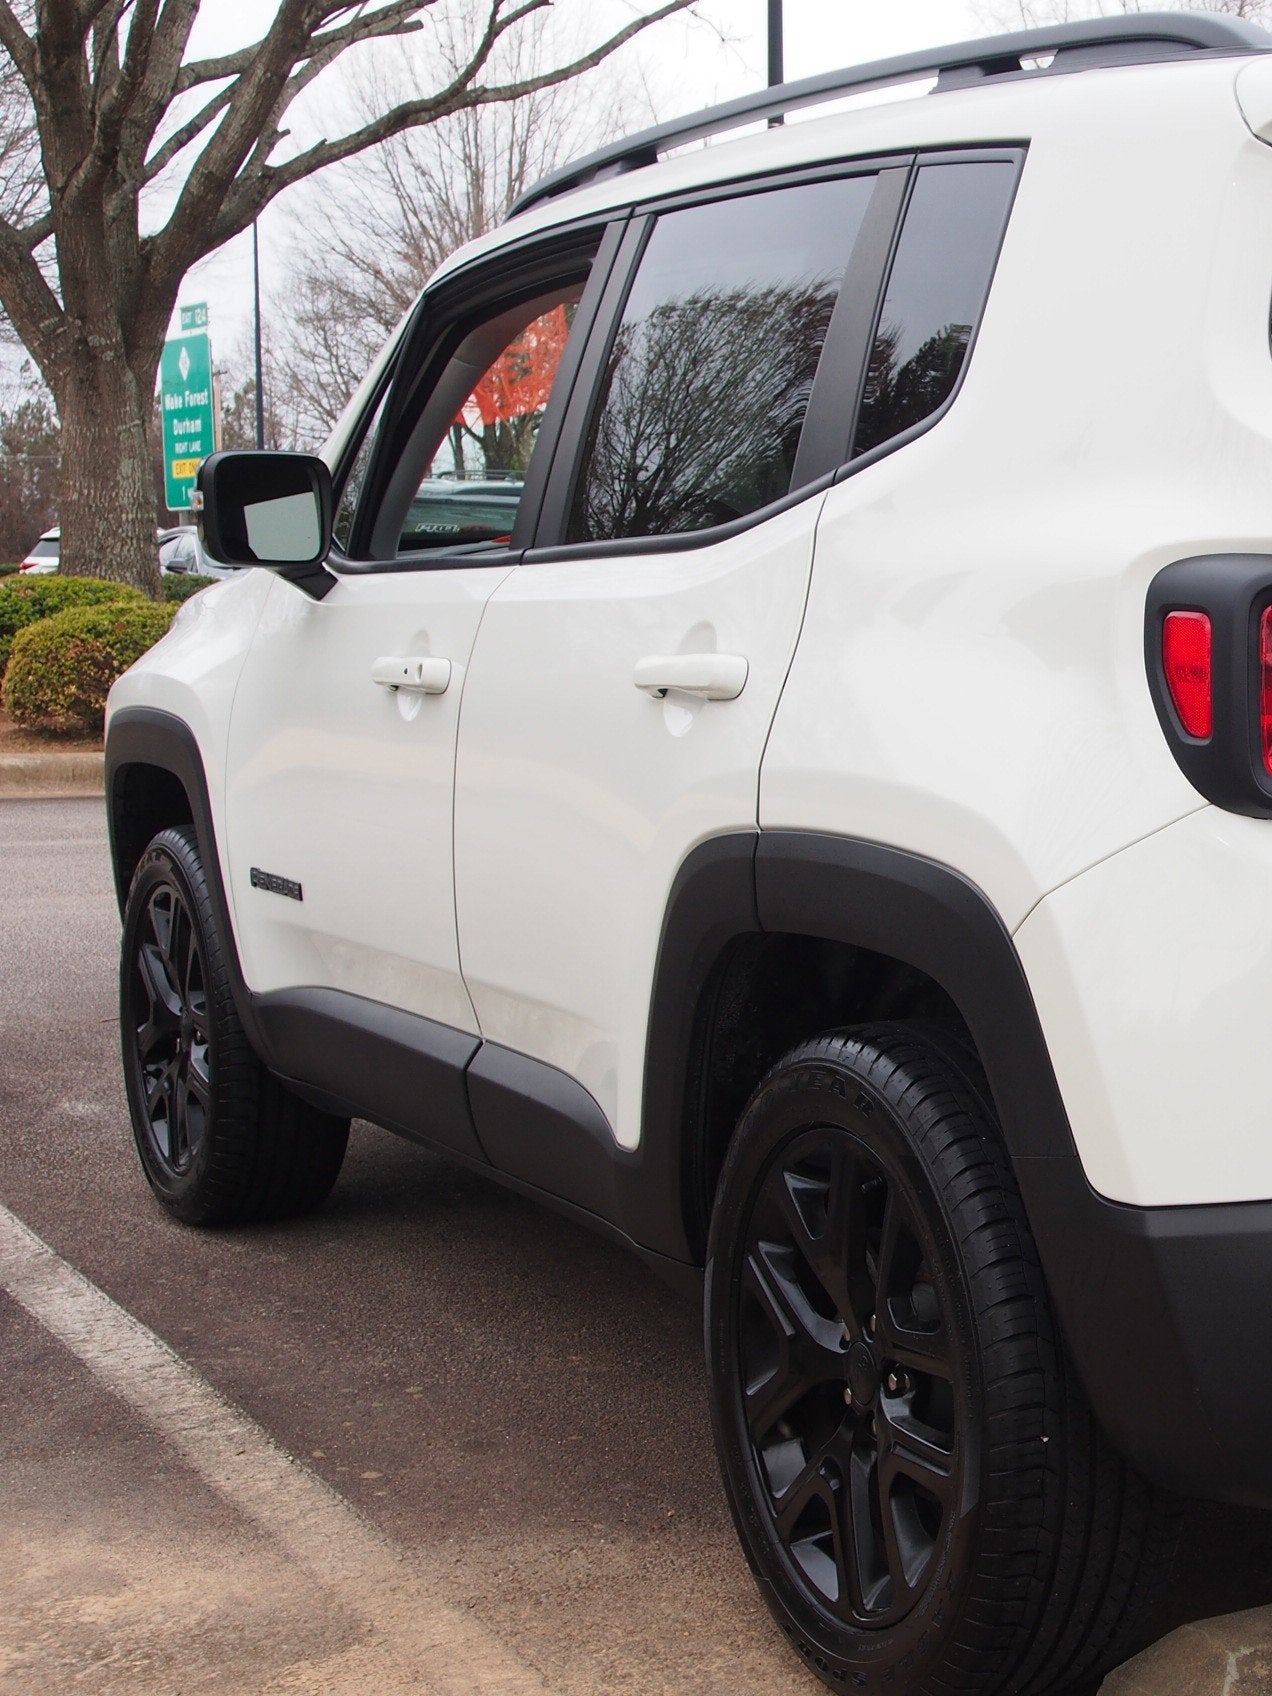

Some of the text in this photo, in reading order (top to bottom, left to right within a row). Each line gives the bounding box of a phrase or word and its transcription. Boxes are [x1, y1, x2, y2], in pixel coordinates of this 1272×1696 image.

[165, 389, 208, 410] Wake Forest
[173, 417, 202, 435] Durham
